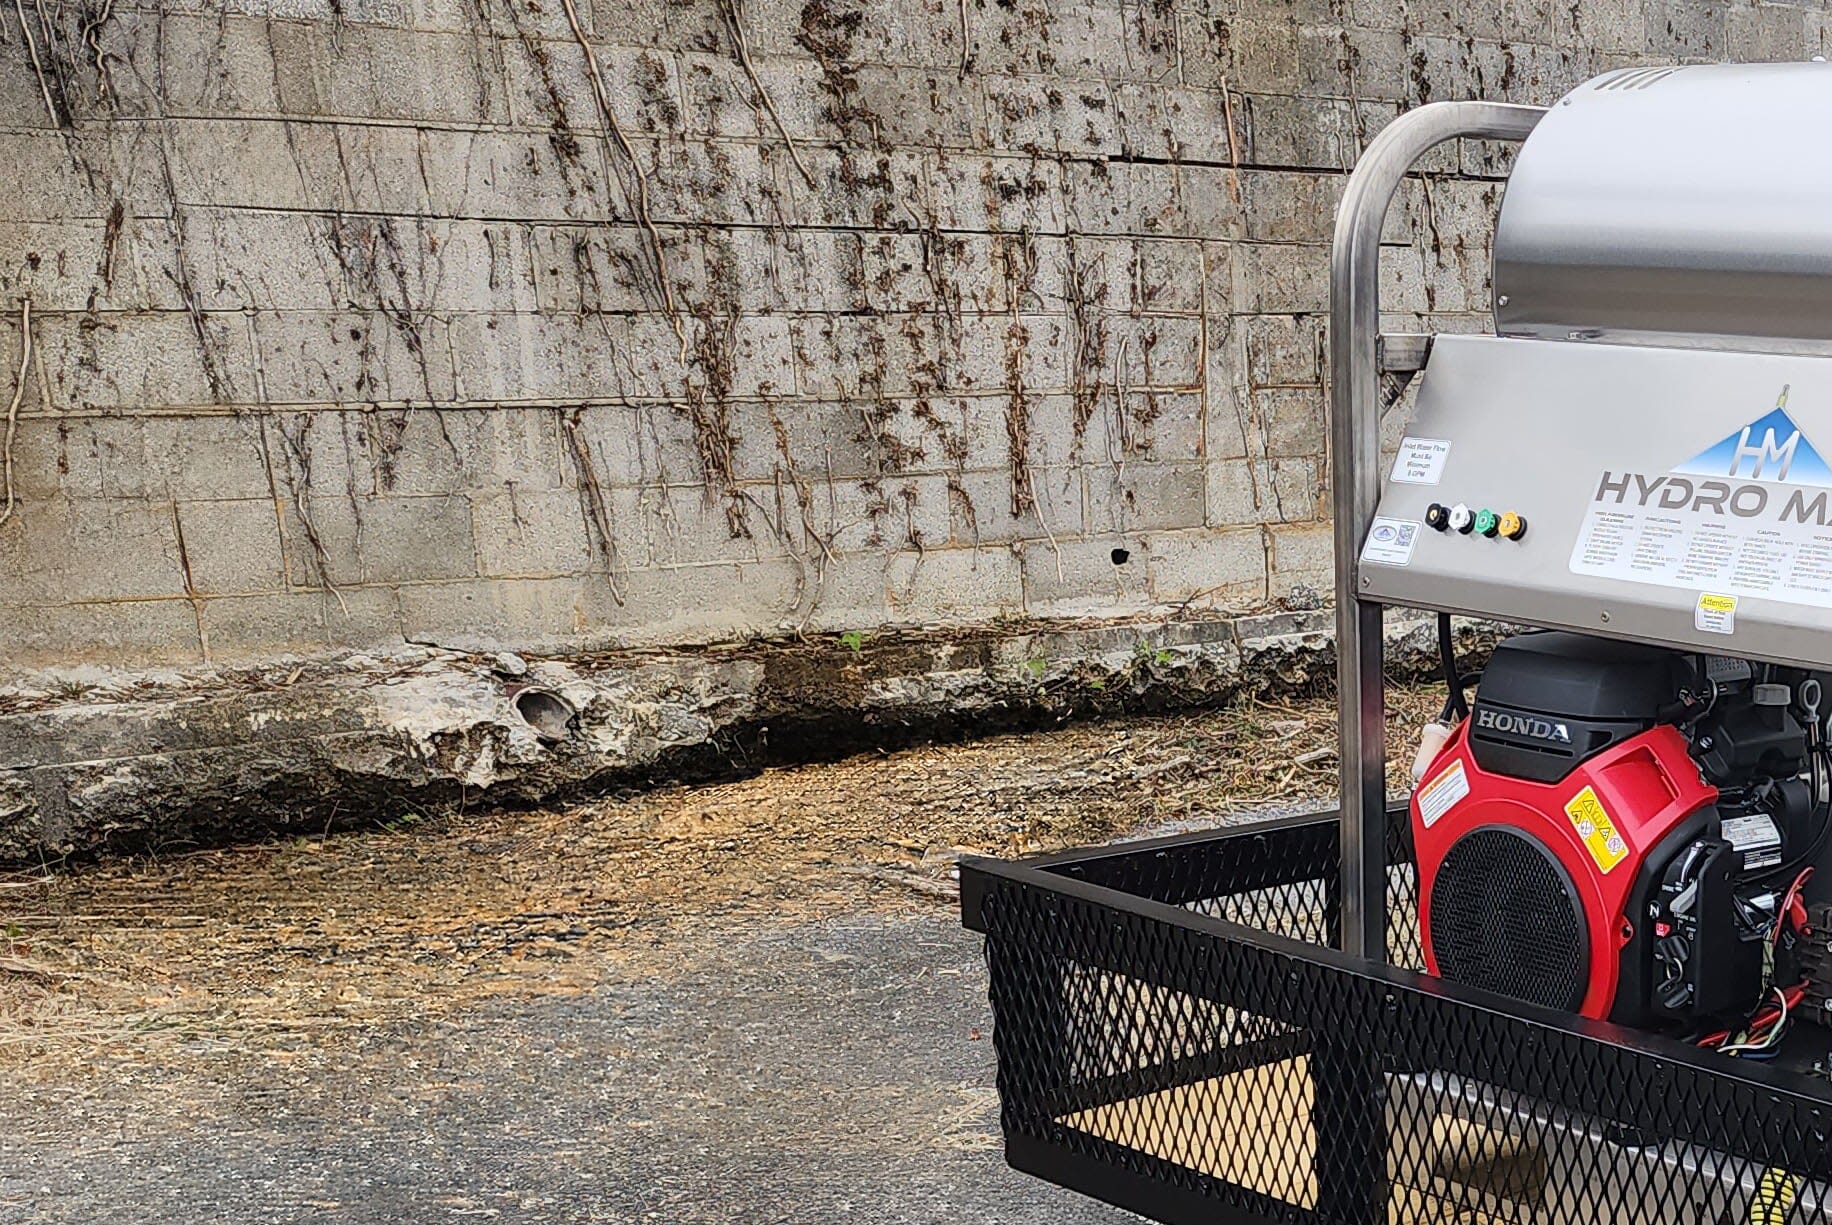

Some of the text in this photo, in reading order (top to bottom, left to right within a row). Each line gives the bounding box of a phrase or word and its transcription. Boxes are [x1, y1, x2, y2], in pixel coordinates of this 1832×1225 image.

[1729, 426, 1800, 482] HM
[1595, 471, 1768, 518] HYDRO
[1476, 709, 1572, 744] HONDA
